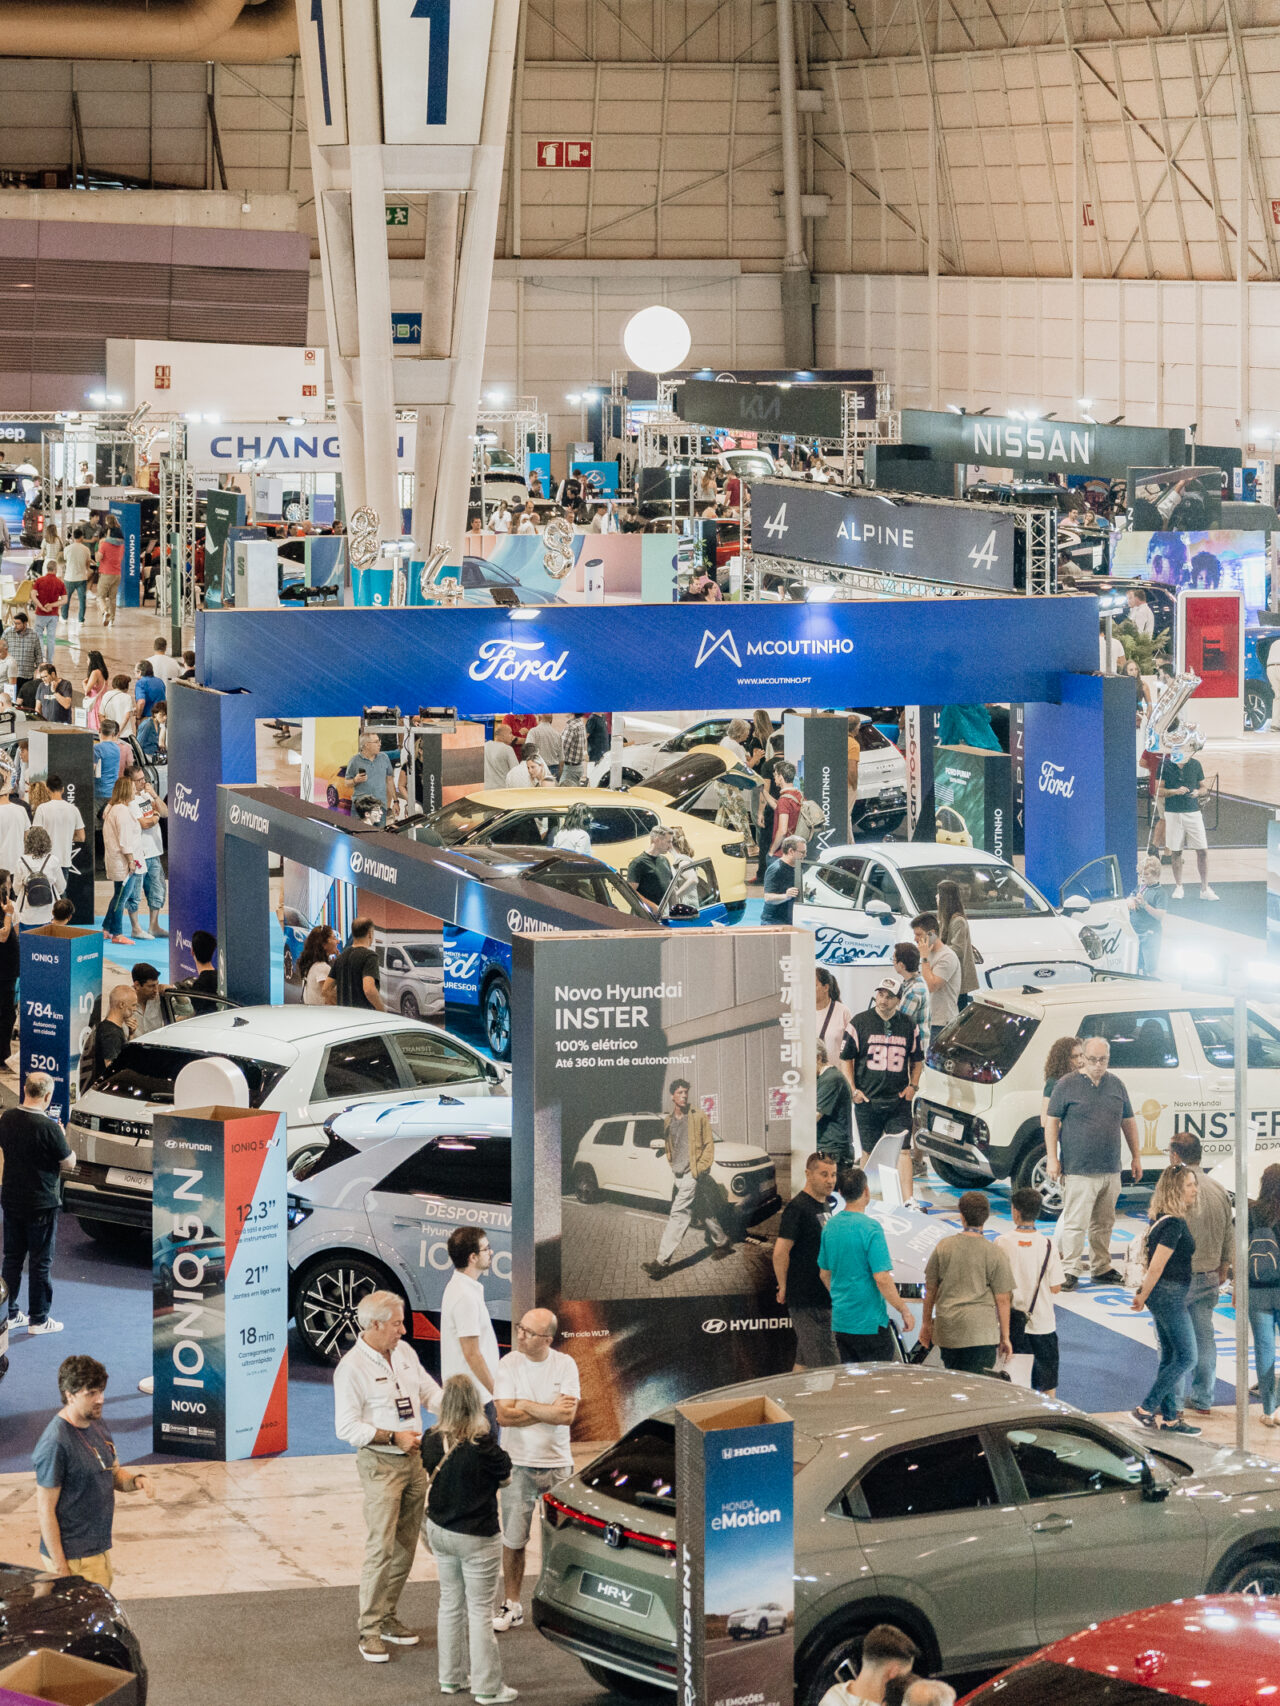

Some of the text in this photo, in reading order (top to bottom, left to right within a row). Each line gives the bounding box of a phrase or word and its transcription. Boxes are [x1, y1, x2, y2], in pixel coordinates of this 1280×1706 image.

[410, 0, 449, 126] 1
[973, 423, 1090, 465] NISSAN
[836, 521, 914, 549] ALPINE
[747, 638, 854, 656] MCOUTINHO
[468, 639, 569, 682] Ford
[737, 677, 811, 685] WWW.MCOUTINHO.PT
[1038, 760, 1075, 799] Ford
[173, 782, 200, 822] Ford
[822, 766, 831, 826] MCOUTINHO
[240, 809, 270, 835] HYUNDAI
[994, 808, 1003, 860] COUTINHO
[364, 857, 398, 885] HYUNDAI
[31, 952, 59, 964] IONIQ 5
[554, 981, 683, 1003] Novo Hyundai
[26, 1000, 64, 1021] 784 km
[555, 1005, 649, 1031] INSTER
[555, 1038, 638, 1053] 100% elétrico
[30, 1054, 56, 1072] 520
[555, 1056, 573, 1070] Até
[575, 1057, 596, 1068] 360
[598, 1057, 614, 1068] km
[616, 1056, 630, 1067] de
[866, 1045, 907, 1073] 36
[121, 1125, 150, 1136] IONIQ
[1174, 1111, 1280, 1139] INSER
[179, 1141, 212, 1152] HYUNDAI
[232, 1141, 257, 1153] IONIQ
[419, 1240, 512, 1284] IOQ
[173, 1167, 210, 1389] IONIQ 5 N
[576, 1330, 591, 1338] ciclo
[730, 1317, 793, 1332] HYUNDAI
[239, 1327, 275, 1346] 18 min
[171, 1400, 207, 1414] NOVO
[733, 1443, 778, 1458] HONDA
[721, 1500, 755, 1511] HONDA
[711, 1507, 781, 1531] eMotion
